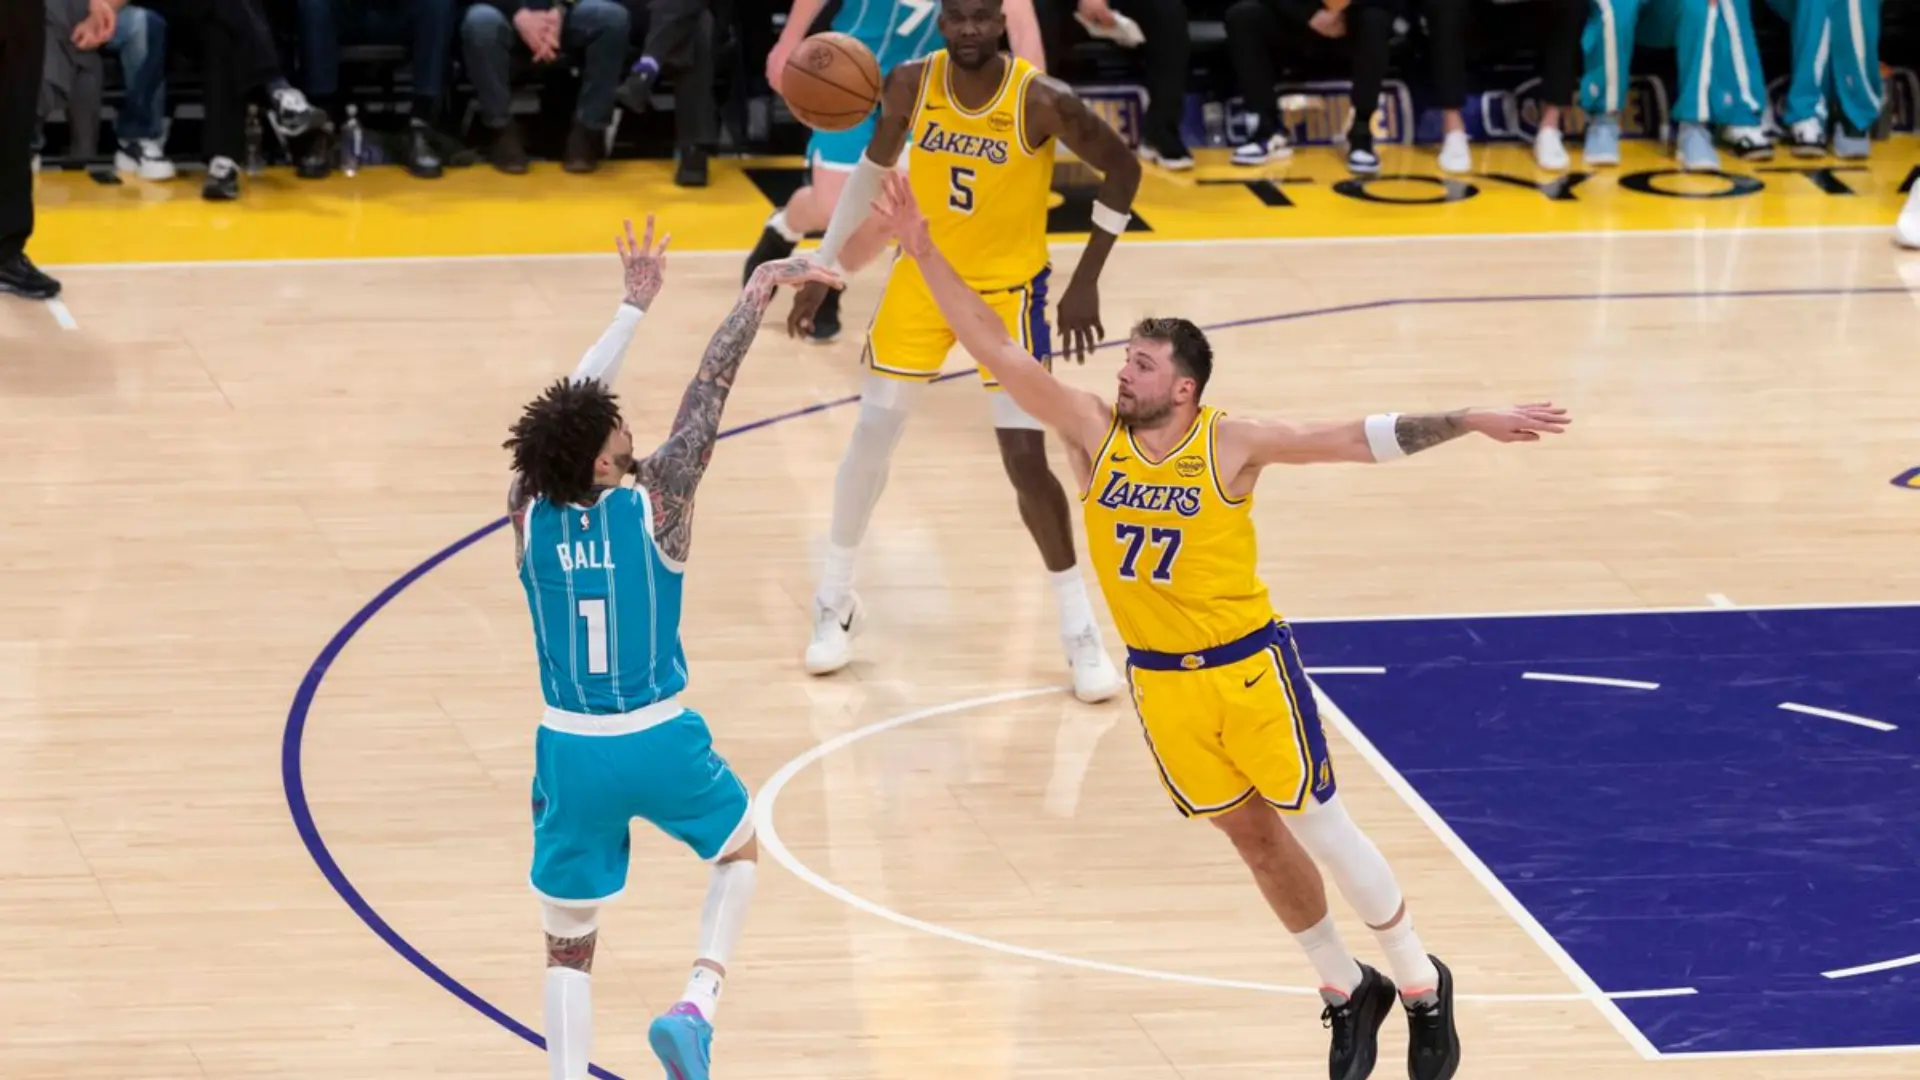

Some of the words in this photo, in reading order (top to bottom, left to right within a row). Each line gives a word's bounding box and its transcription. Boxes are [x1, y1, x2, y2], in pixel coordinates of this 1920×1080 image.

[895, 0, 936, 37] 7
[918, 121, 1009, 165] LAKERS
[948, 166, 976, 214] 5
[1097, 470, 1201, 517] LAKERS
[556, 540, 615, 572] BALL
[1115, 521, 1183, 583] 77
[578, 598, 609, 675] 1
